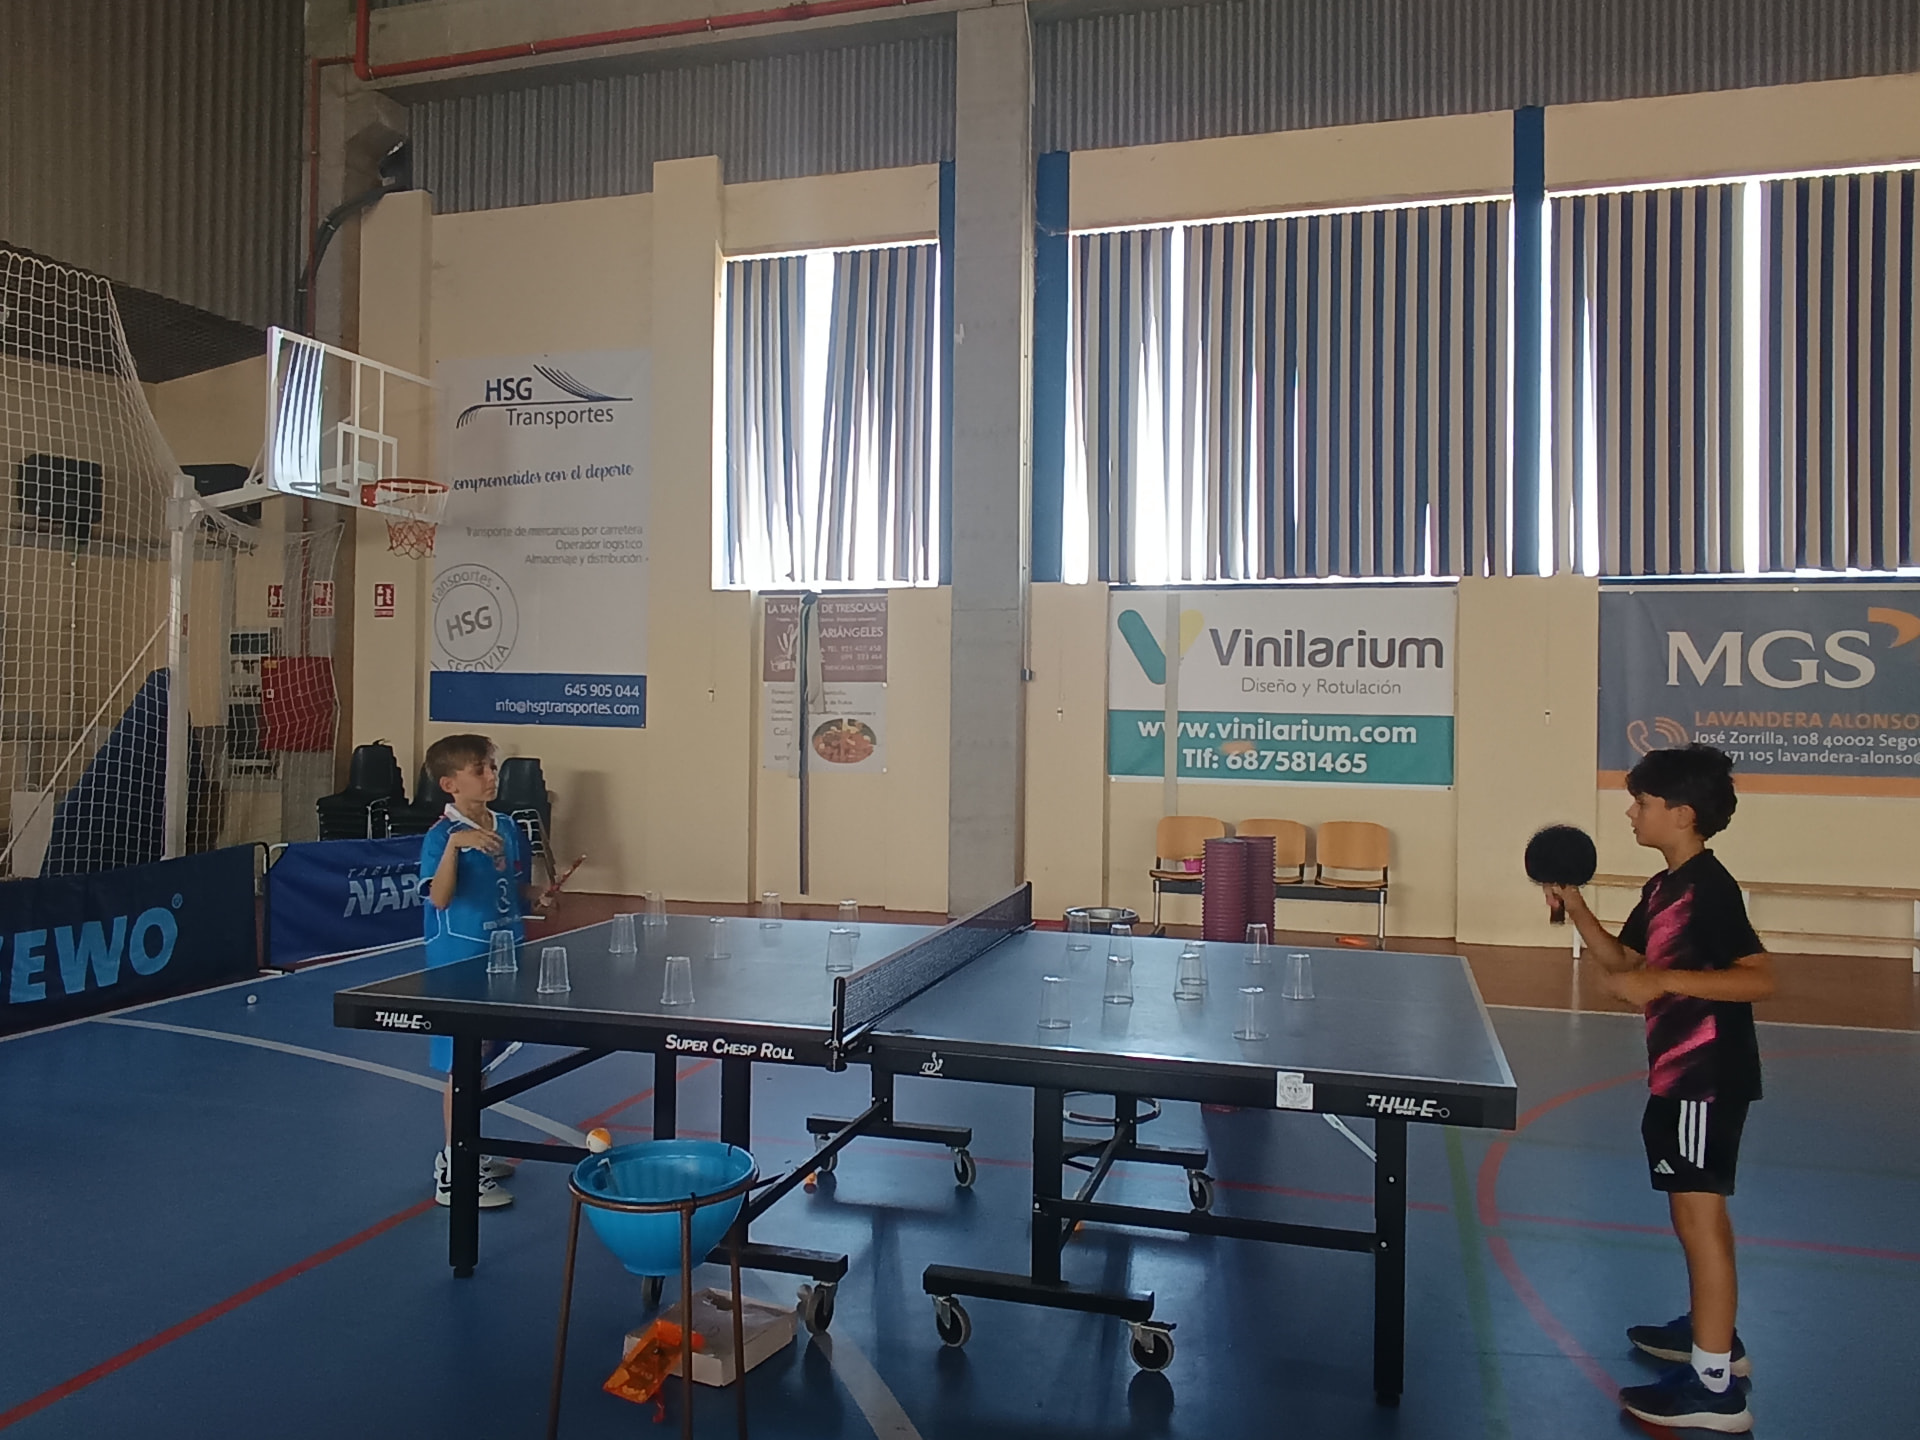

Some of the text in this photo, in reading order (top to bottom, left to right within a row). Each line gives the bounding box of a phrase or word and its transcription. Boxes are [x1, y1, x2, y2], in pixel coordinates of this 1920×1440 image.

[485, 377, 533, 402] HSG
[505, 407, 615, 429] Transportes
[452, 464, 634, 493] omprometidos con el deporte
[466, 526, 513, 538] Transporte
[514, 526, 526, 537] de
[581, 526, 599, 538] por
[600, 525, 643, 536] carretera
[555, 540, 601, 553] Operador
[525, 553, 577, 566] Almacenaje
[767, 602, 887, 614] LA TAH DE TRESCASAS
[446, 605, 493, 641] HSG
[819, 625, 884, 638] ARIÁNGELES
[1208, 628, 1444, 669] Vinilarium
[1665, 629, 1877, 689] MGS
[564, 683, 640, 698] 645 905 044
[1241, 677, 1402, 697] Diseño y Rotulación
[495, 698, 640, 716] info@hsgtransportes.com
[1695, 711, 1920, 730] LAVANDERA ALONSO
[1692, 730, 1920, 752] José Zorrilla, 108 40002 Sego
[1182, 747, 1368, 775] Tlf: 687581465
[1749, 751, 1774, 764] 105
[343, 873, 424, 917] NAR
[0, 907, 179, 1004] EWO
[374, 1011, 424, 1029] THULE
[1366, 1094, 1438, 1118] THULE
